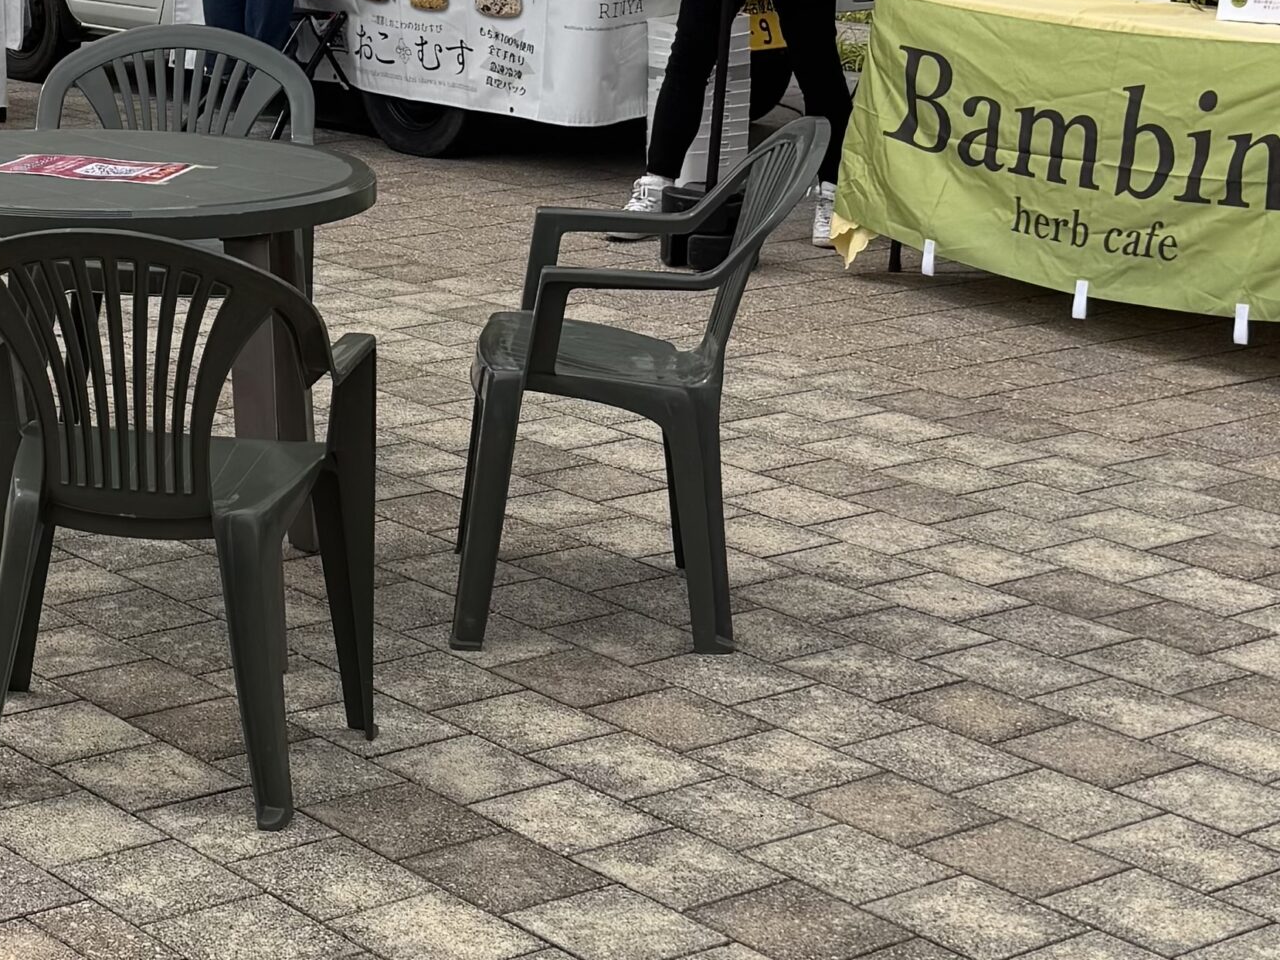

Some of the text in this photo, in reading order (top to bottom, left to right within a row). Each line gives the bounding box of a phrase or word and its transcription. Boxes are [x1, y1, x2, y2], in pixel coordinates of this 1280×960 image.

[487, 44, 525, 66] 全て手作り
[485, 76, 527, 96] 真空パック
[883, 44, 1280, 211] Bambin
[1011, 197, 1179, 263] herb cafe
